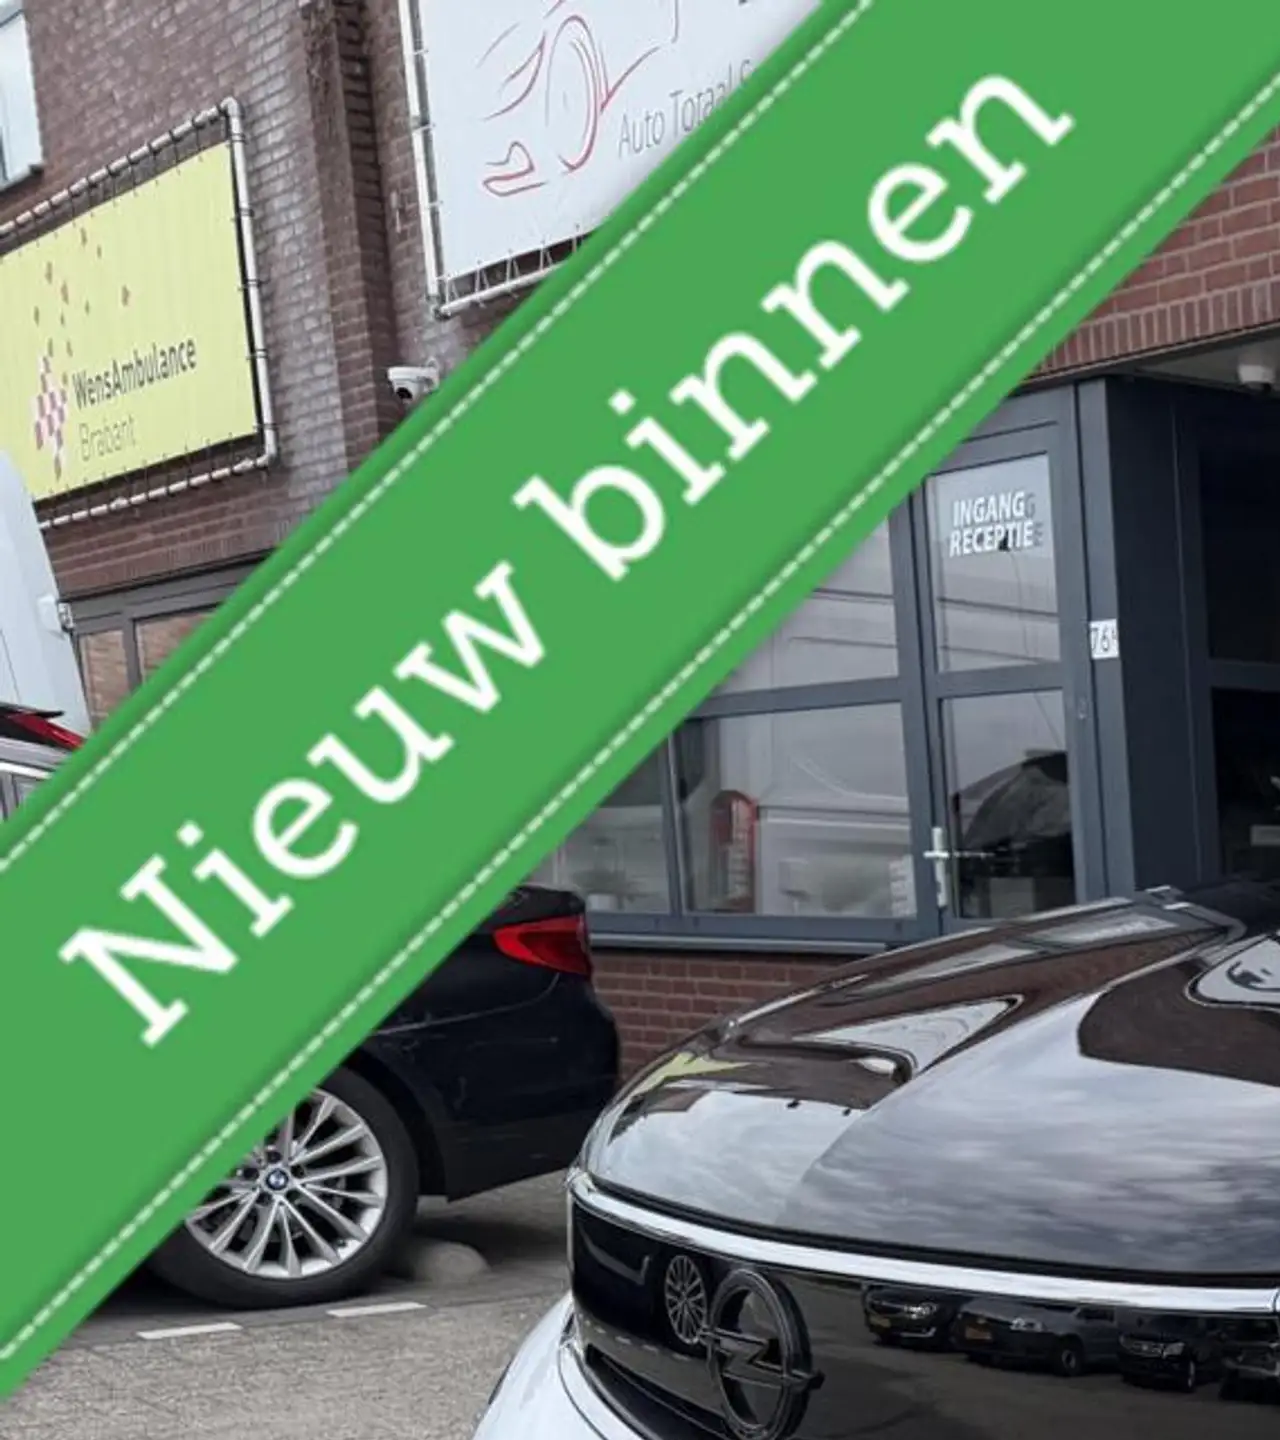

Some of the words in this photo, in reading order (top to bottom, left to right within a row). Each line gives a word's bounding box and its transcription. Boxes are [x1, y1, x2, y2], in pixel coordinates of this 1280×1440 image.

[618, 110, 666, 158] Auto
[72, 339, 197, 410] WensAmbulance
[79, 414, 136, 461] Brabant
[952, 491, 1026, 528] INGANG
[949, 519, 1035, 558] RECEPTIE
